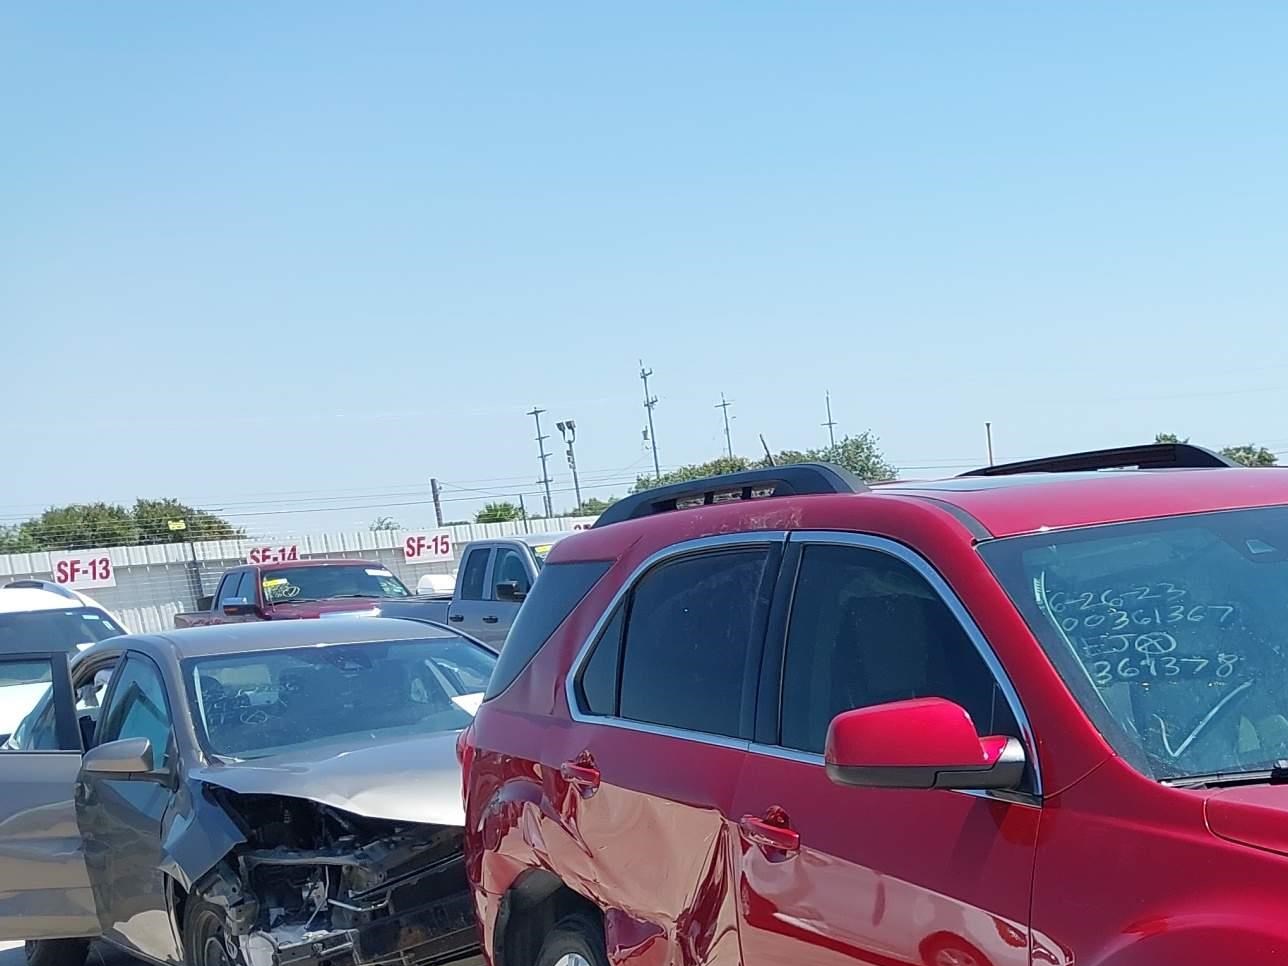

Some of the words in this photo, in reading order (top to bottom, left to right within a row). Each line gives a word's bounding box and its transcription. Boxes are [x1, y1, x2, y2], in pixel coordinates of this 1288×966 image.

[250, 545, 298, 563] SF-14
[406, 534, 450, 558] SF-15
[56, 557, 111, 584] SF-13
[1049, 583, 1187, 612] 6-26-23
[1062, 605, 1234, 632] 00361367
